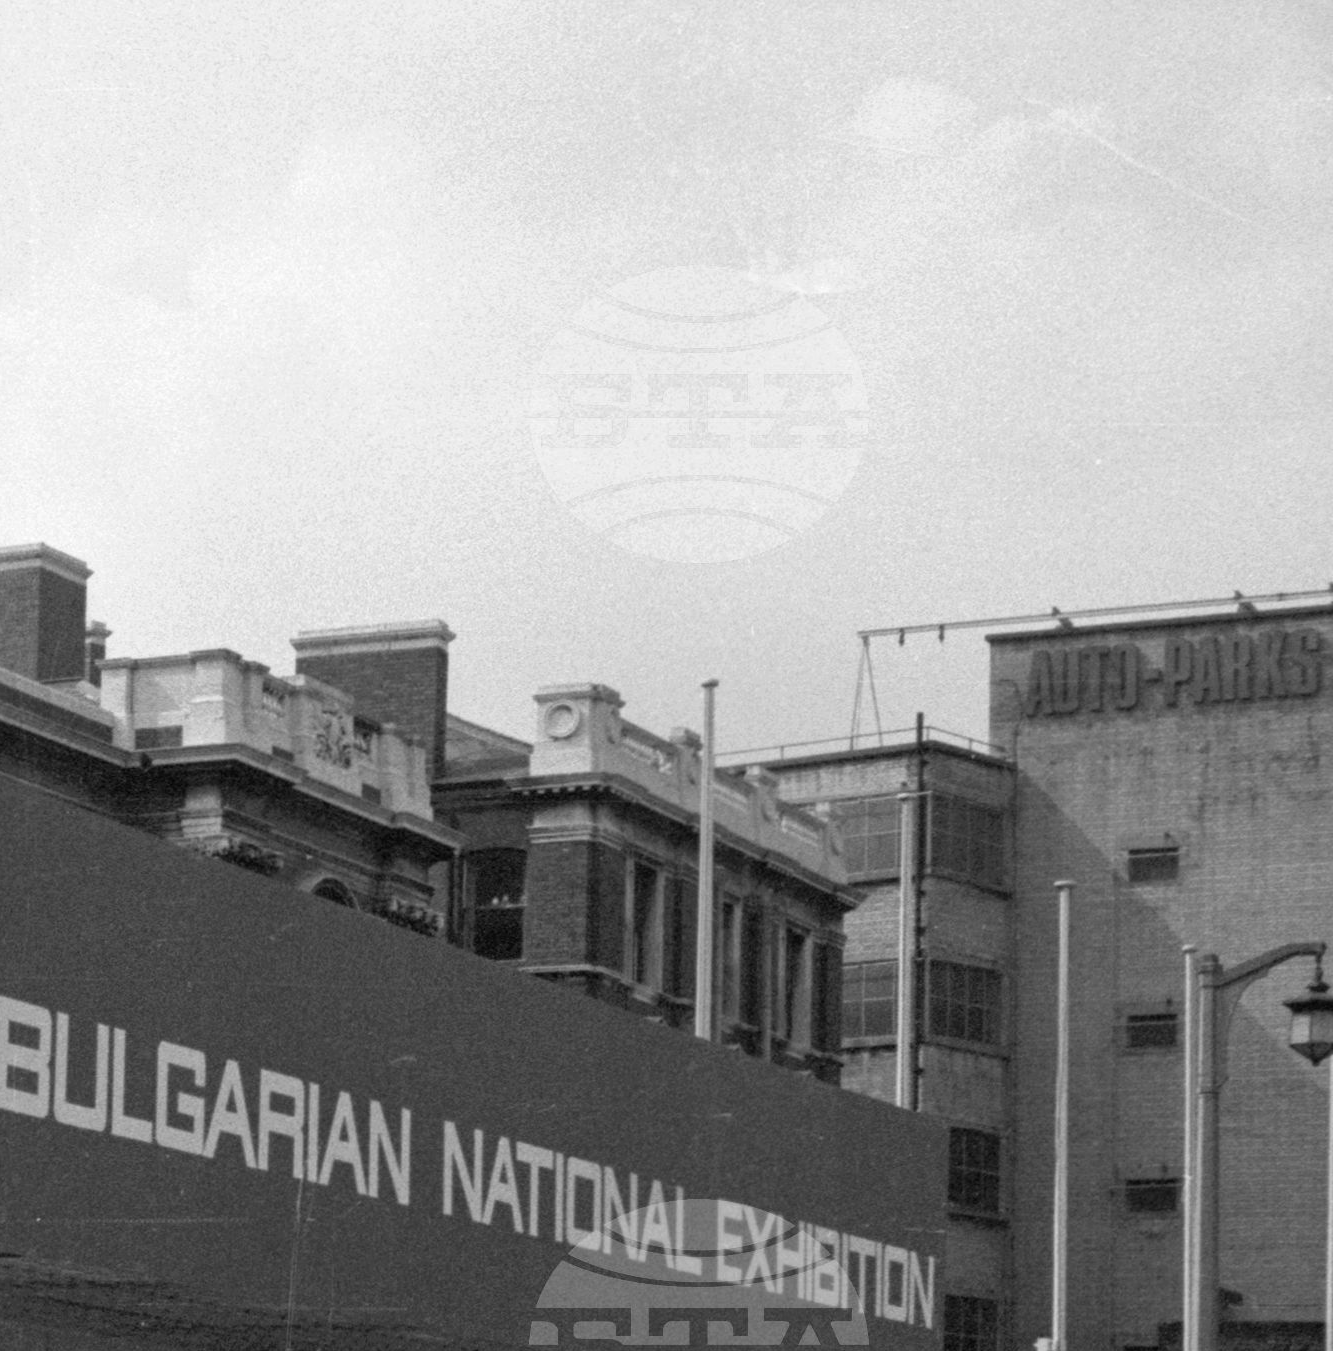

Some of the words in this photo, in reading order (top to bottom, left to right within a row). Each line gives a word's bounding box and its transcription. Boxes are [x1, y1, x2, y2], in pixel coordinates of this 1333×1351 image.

[1026, 628, 1323, 717] AUTO-PARKS
[442, 1119, 703, 1276] NATIONAL
[716, 1198, 937, 1331] EXHIBITION
